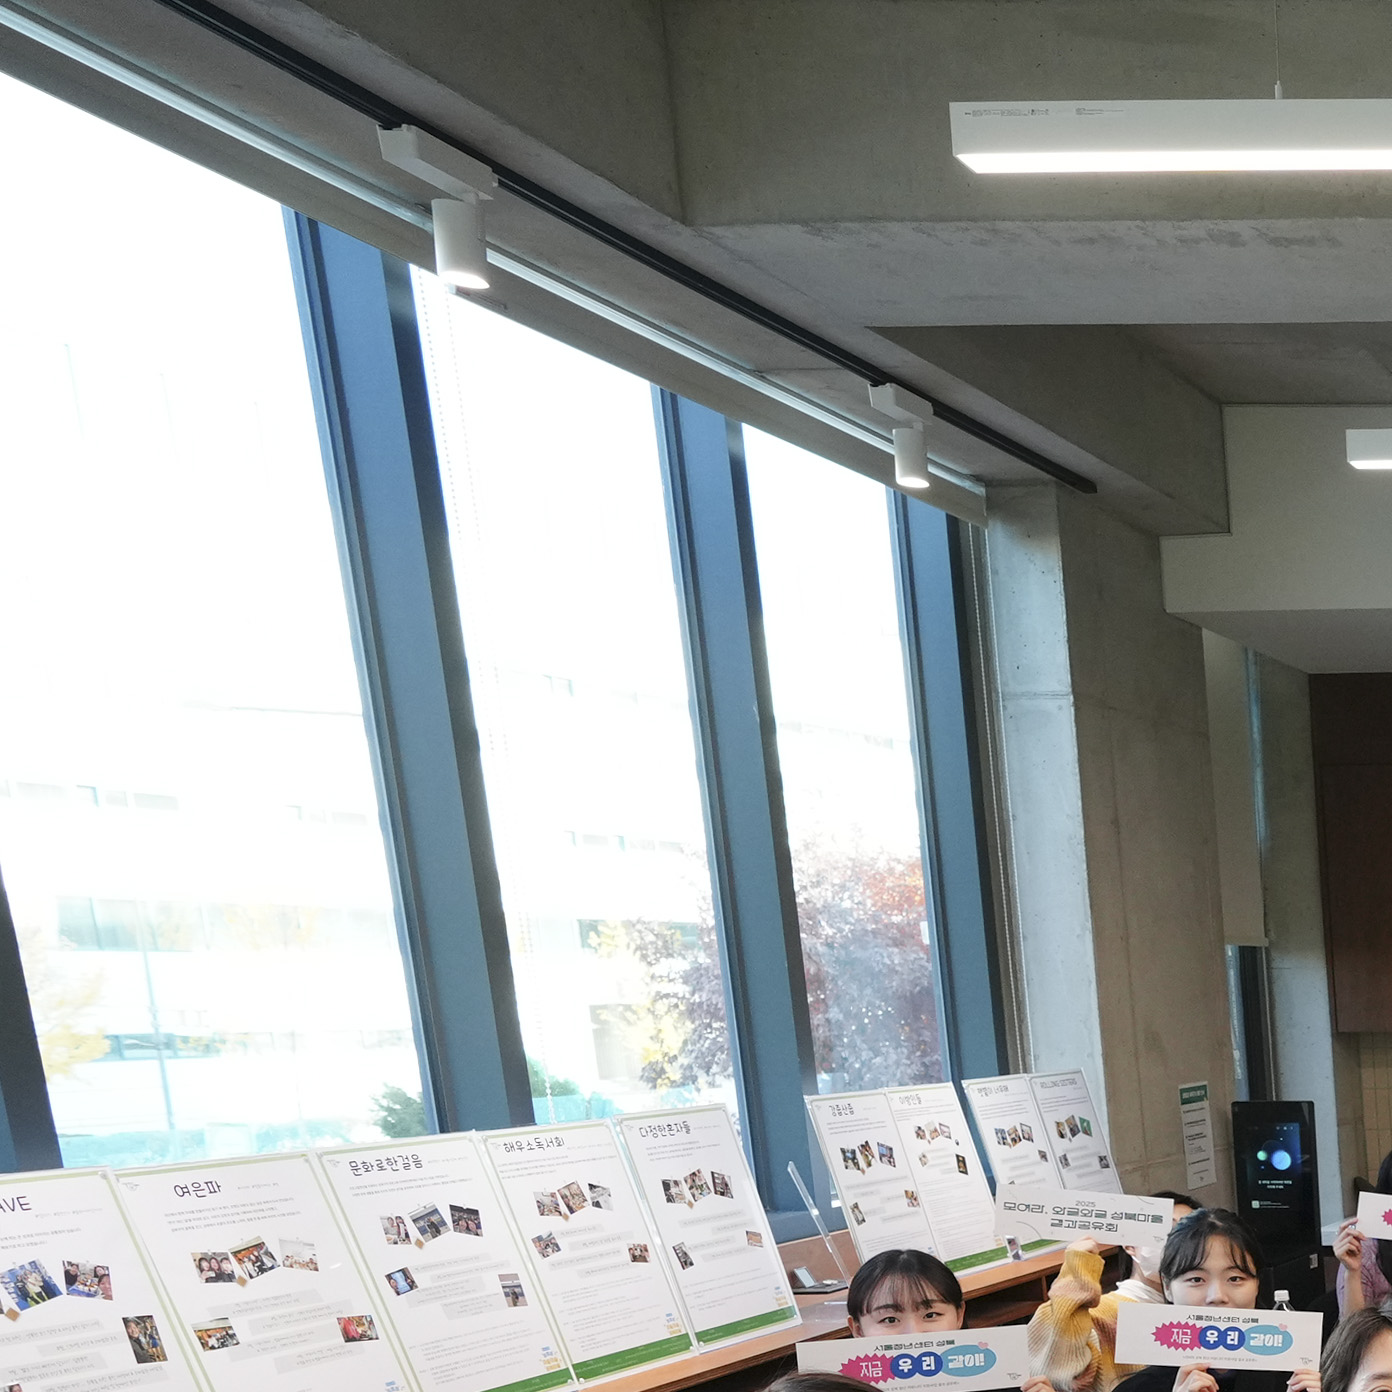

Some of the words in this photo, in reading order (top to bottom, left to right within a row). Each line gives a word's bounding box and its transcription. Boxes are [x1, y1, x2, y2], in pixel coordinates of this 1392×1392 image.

[639, 1120, 692, 1140] 다정한혼자들
[503, 1136, 566, 1154] 해우소독서회
[348, 1154, 423, 1178] 문화로한걸음
[173, 1180, 222, 1199] 여은파
[1003, 1201, 1048, 1215] 모여라.
[1052, 1205, 1108, 1220] 와글와글
[1110, 1211, 1164, 1224] 성북마을
[1075, 1200, 1096, 1208] 2025
[1050, 1218, 1119, 1233] 결과공유회
[1185, 1314, 1240, 1323] 서울청년센터
[1242, 1316, 1260, 1324] 성북
[873, 1340, 934, 1352] 서울청년센터
[935, 1339, 956, 1348] 성북
[1171, 1328, 1192, 1345] 지금
[1205, 1330, 1239, 1345] 우리
[1249, 1333, 1283, 1347] 같이!
[859, 1360, 883, 1378] 지금
[898, 1355, 936, 1373] 우리
[948, 1353, 985, 1369] 같이!
